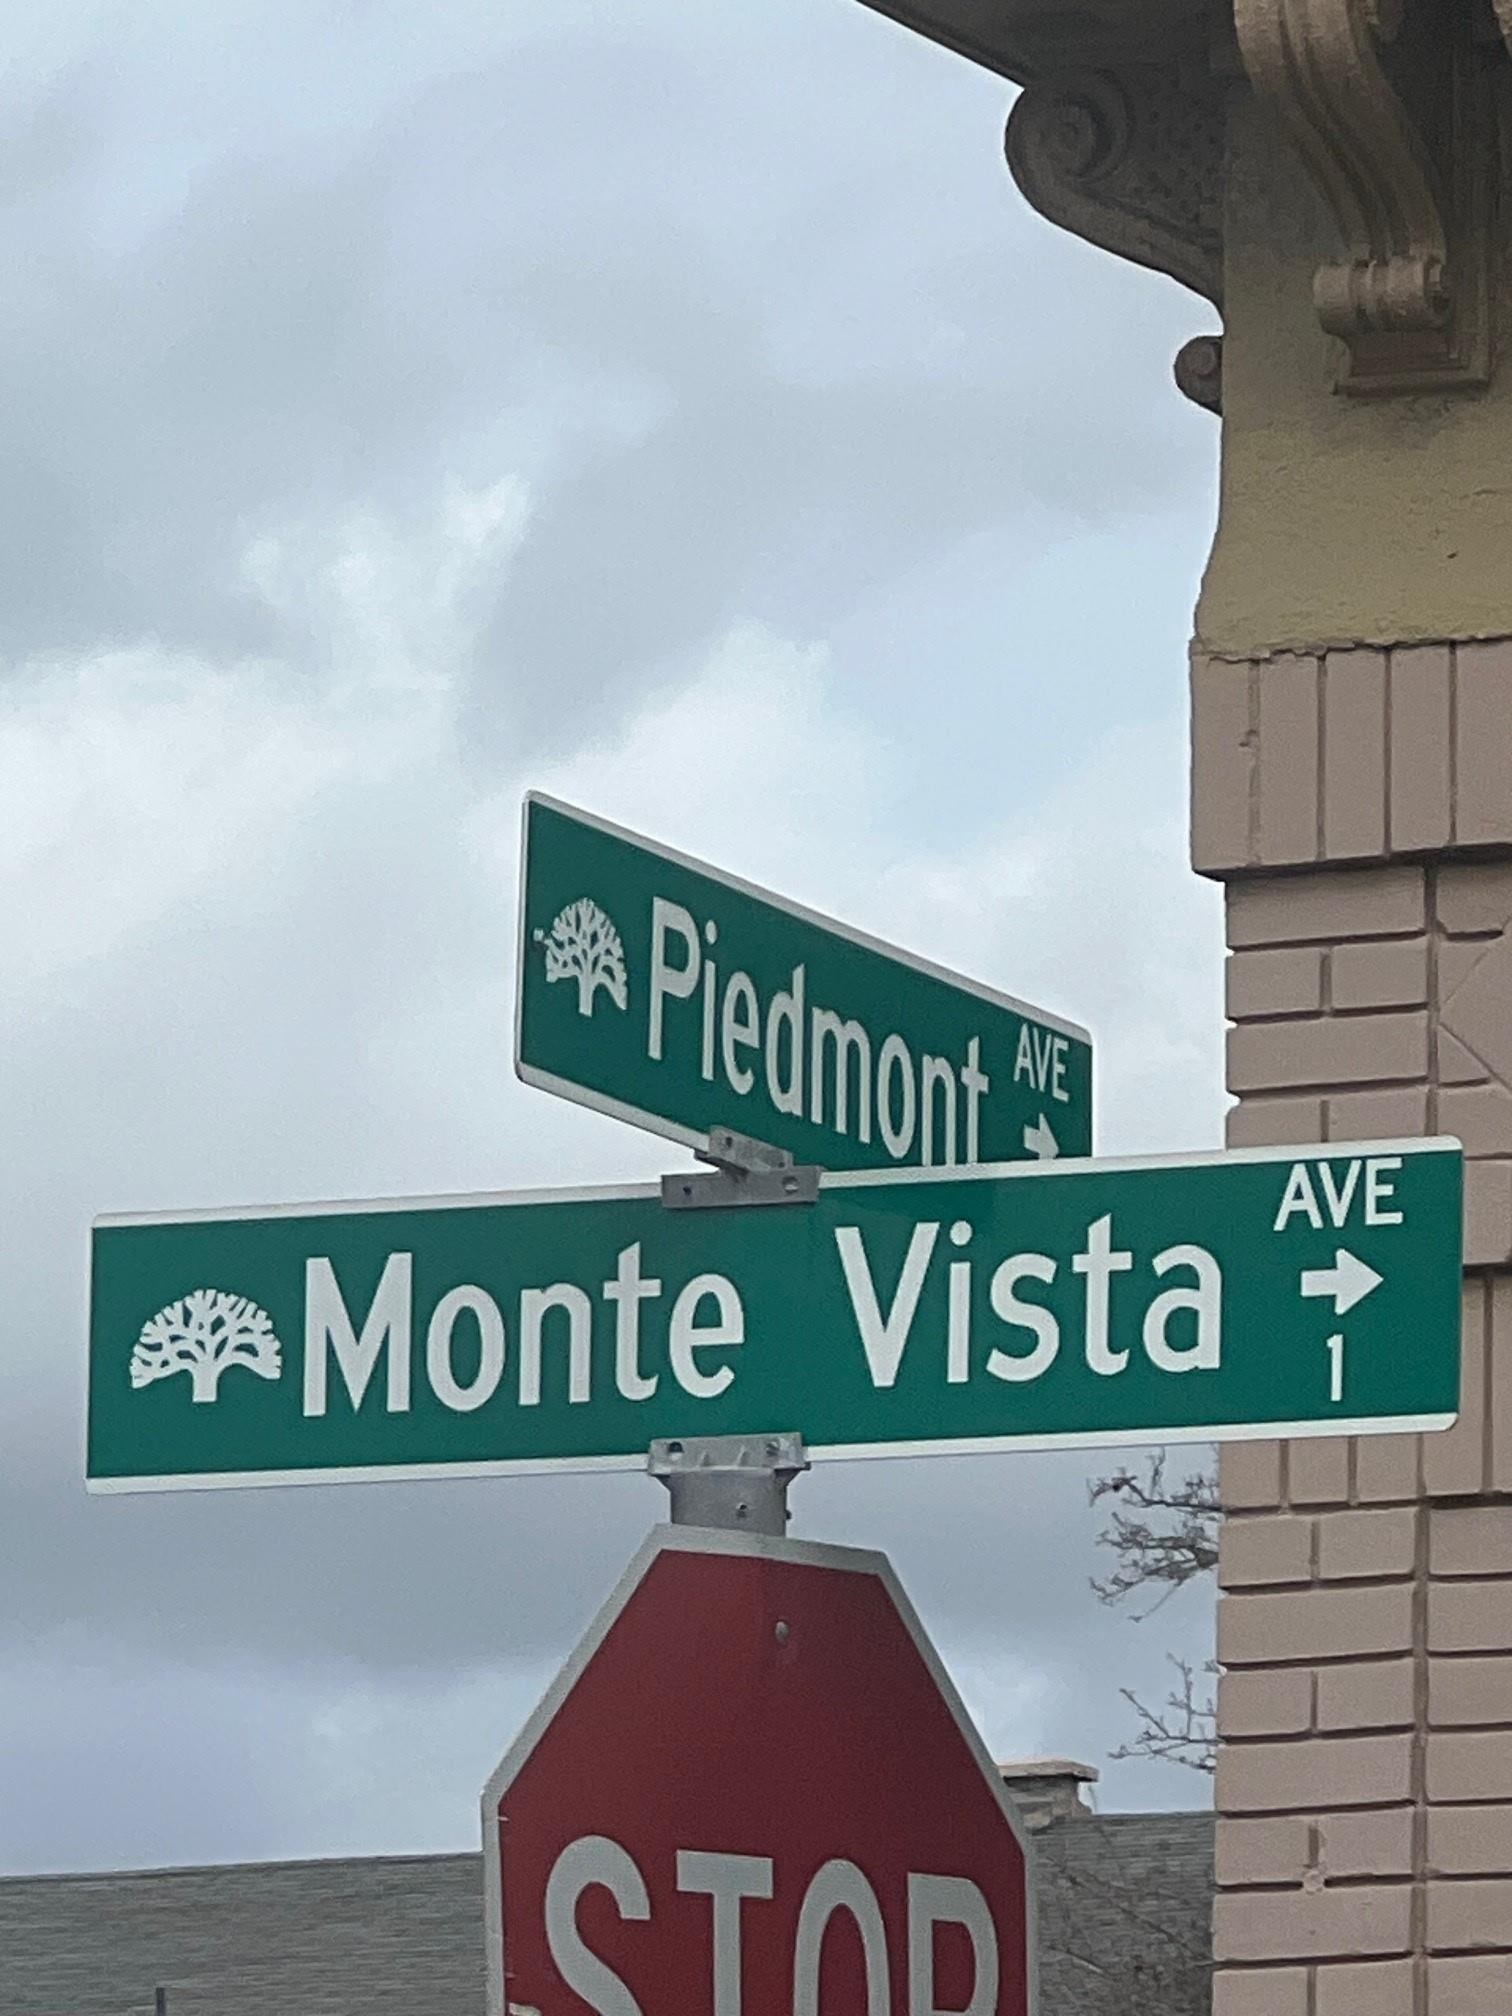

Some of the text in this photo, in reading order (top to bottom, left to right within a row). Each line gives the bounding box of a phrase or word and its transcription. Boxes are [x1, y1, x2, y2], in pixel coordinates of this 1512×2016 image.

[647, 896, 989, 1167] Piedmont
[1013, 1023, 1069, 1103] AVE
[1273, 1157, 1404, 1232] AVE
[303, 1213, 1223, 1416] Monte Vista
[1326, 1333, 1344, 1402] 1
